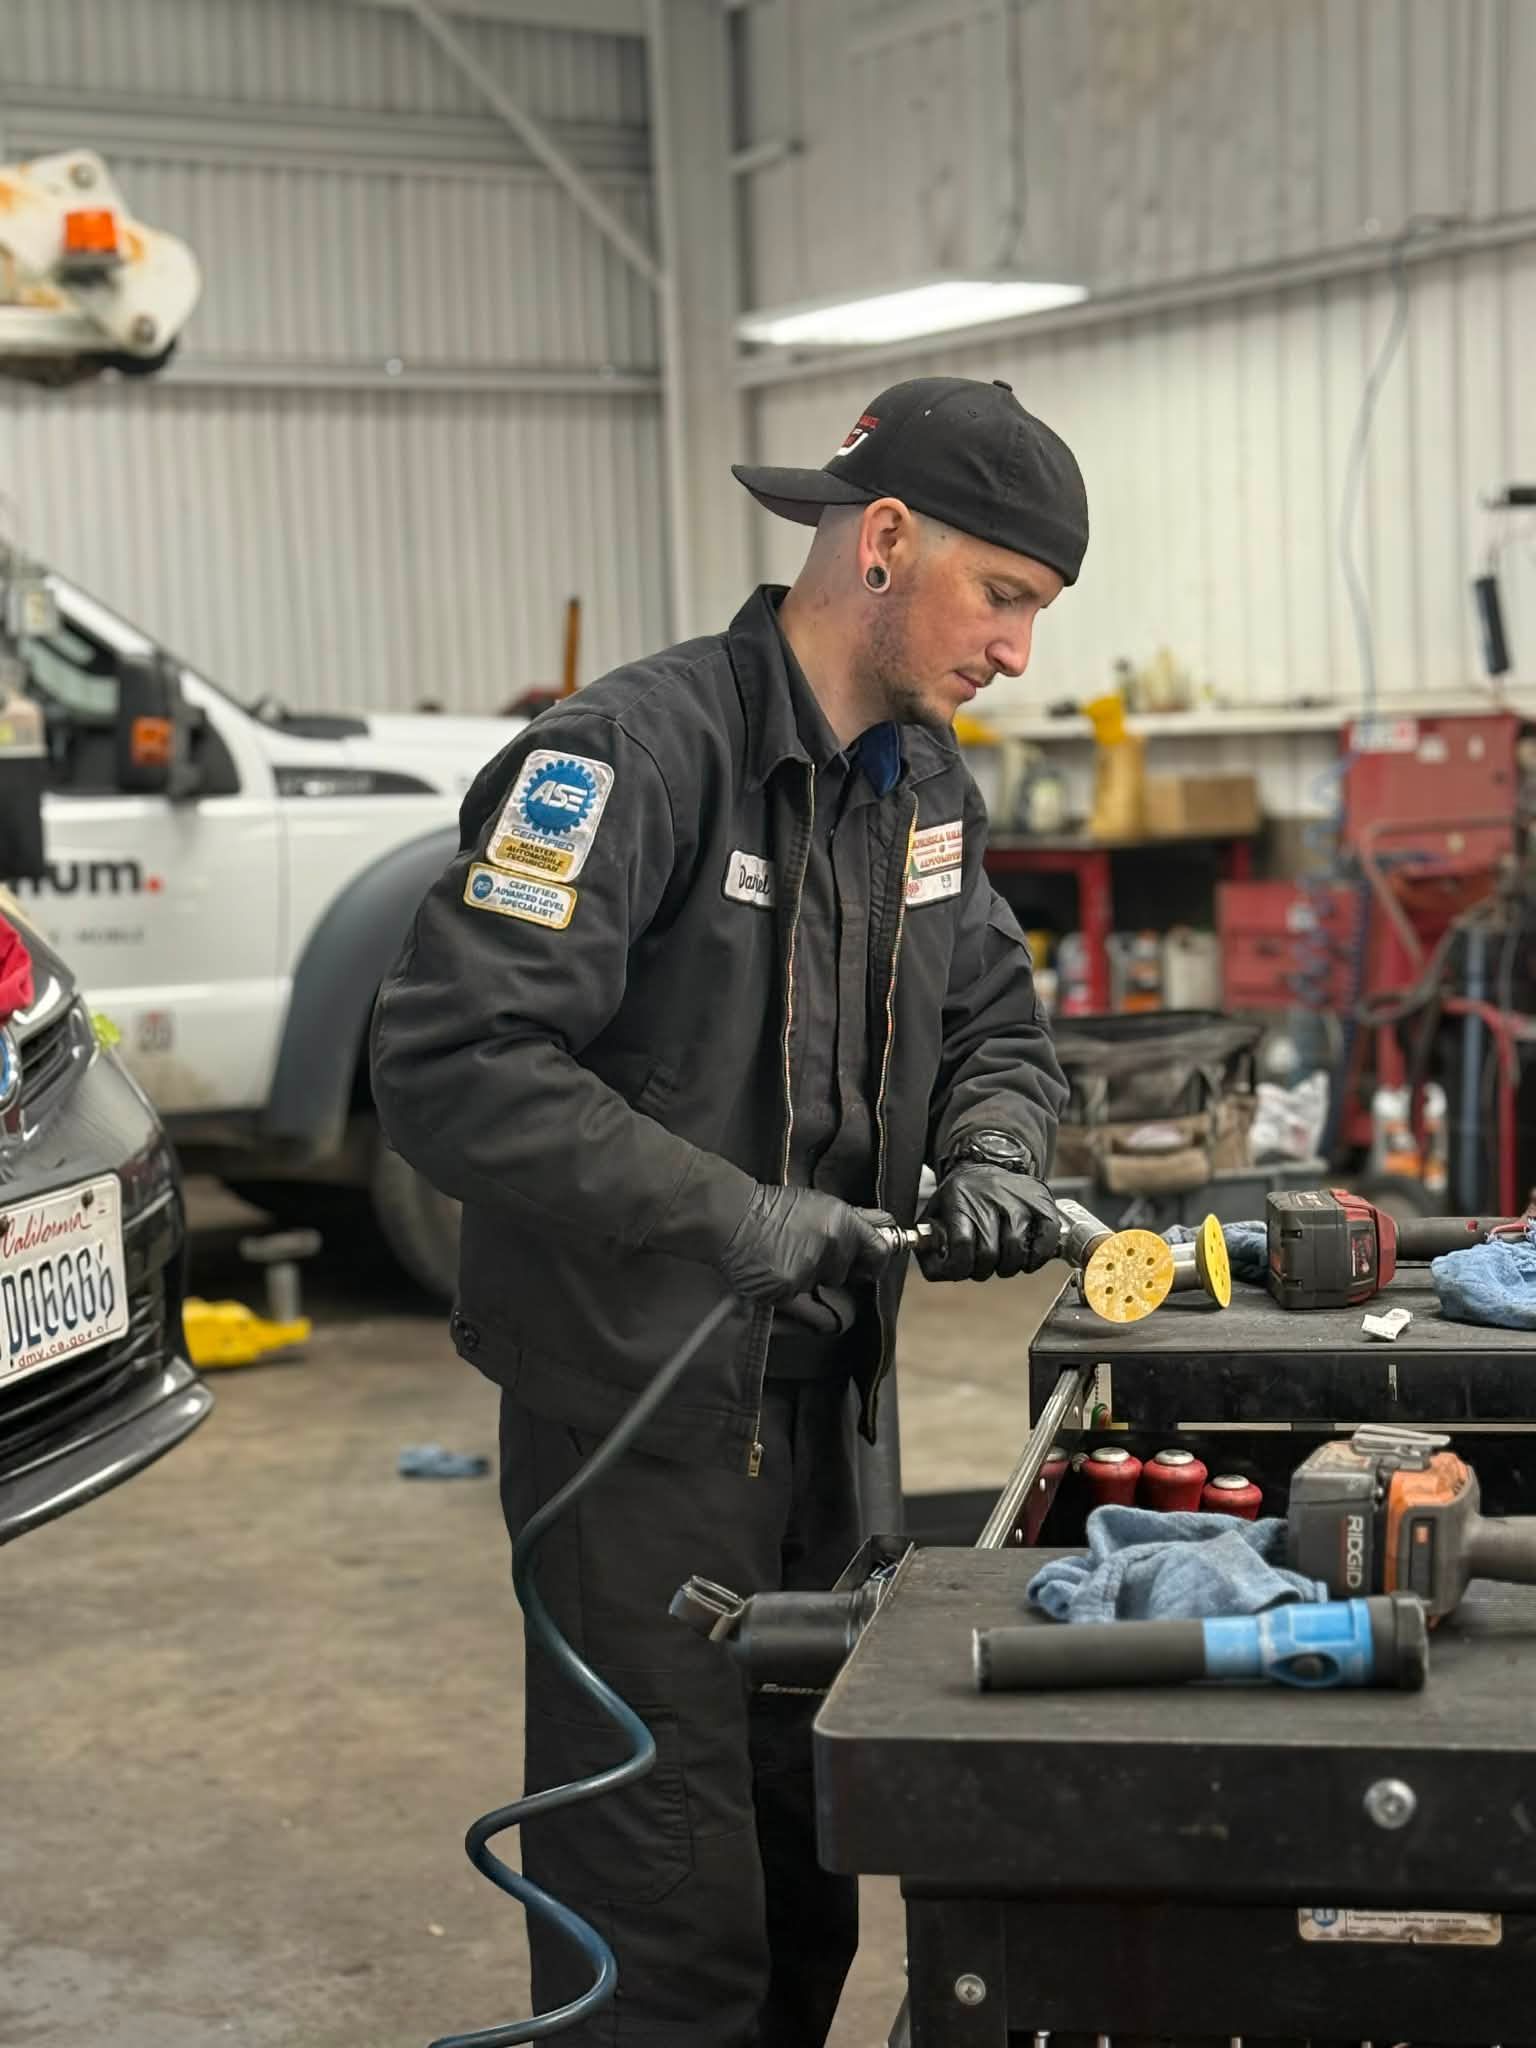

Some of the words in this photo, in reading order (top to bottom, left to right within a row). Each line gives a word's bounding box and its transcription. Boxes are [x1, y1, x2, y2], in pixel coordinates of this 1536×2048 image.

[529, 780, 589, 812] ASE
[512, 828, 575, 852] CERTIFIED
[520, 841, 558, 858] MASTER
[494, 886, 538, 903] ADVANCED
[539, 898, 565, 912] LEVEL
[509, 880, 558, 900] CERTIFIED
[500, 897, 555, 918] SPECIALIST
[1346, 1514, 1364, 1589] RIDGID
